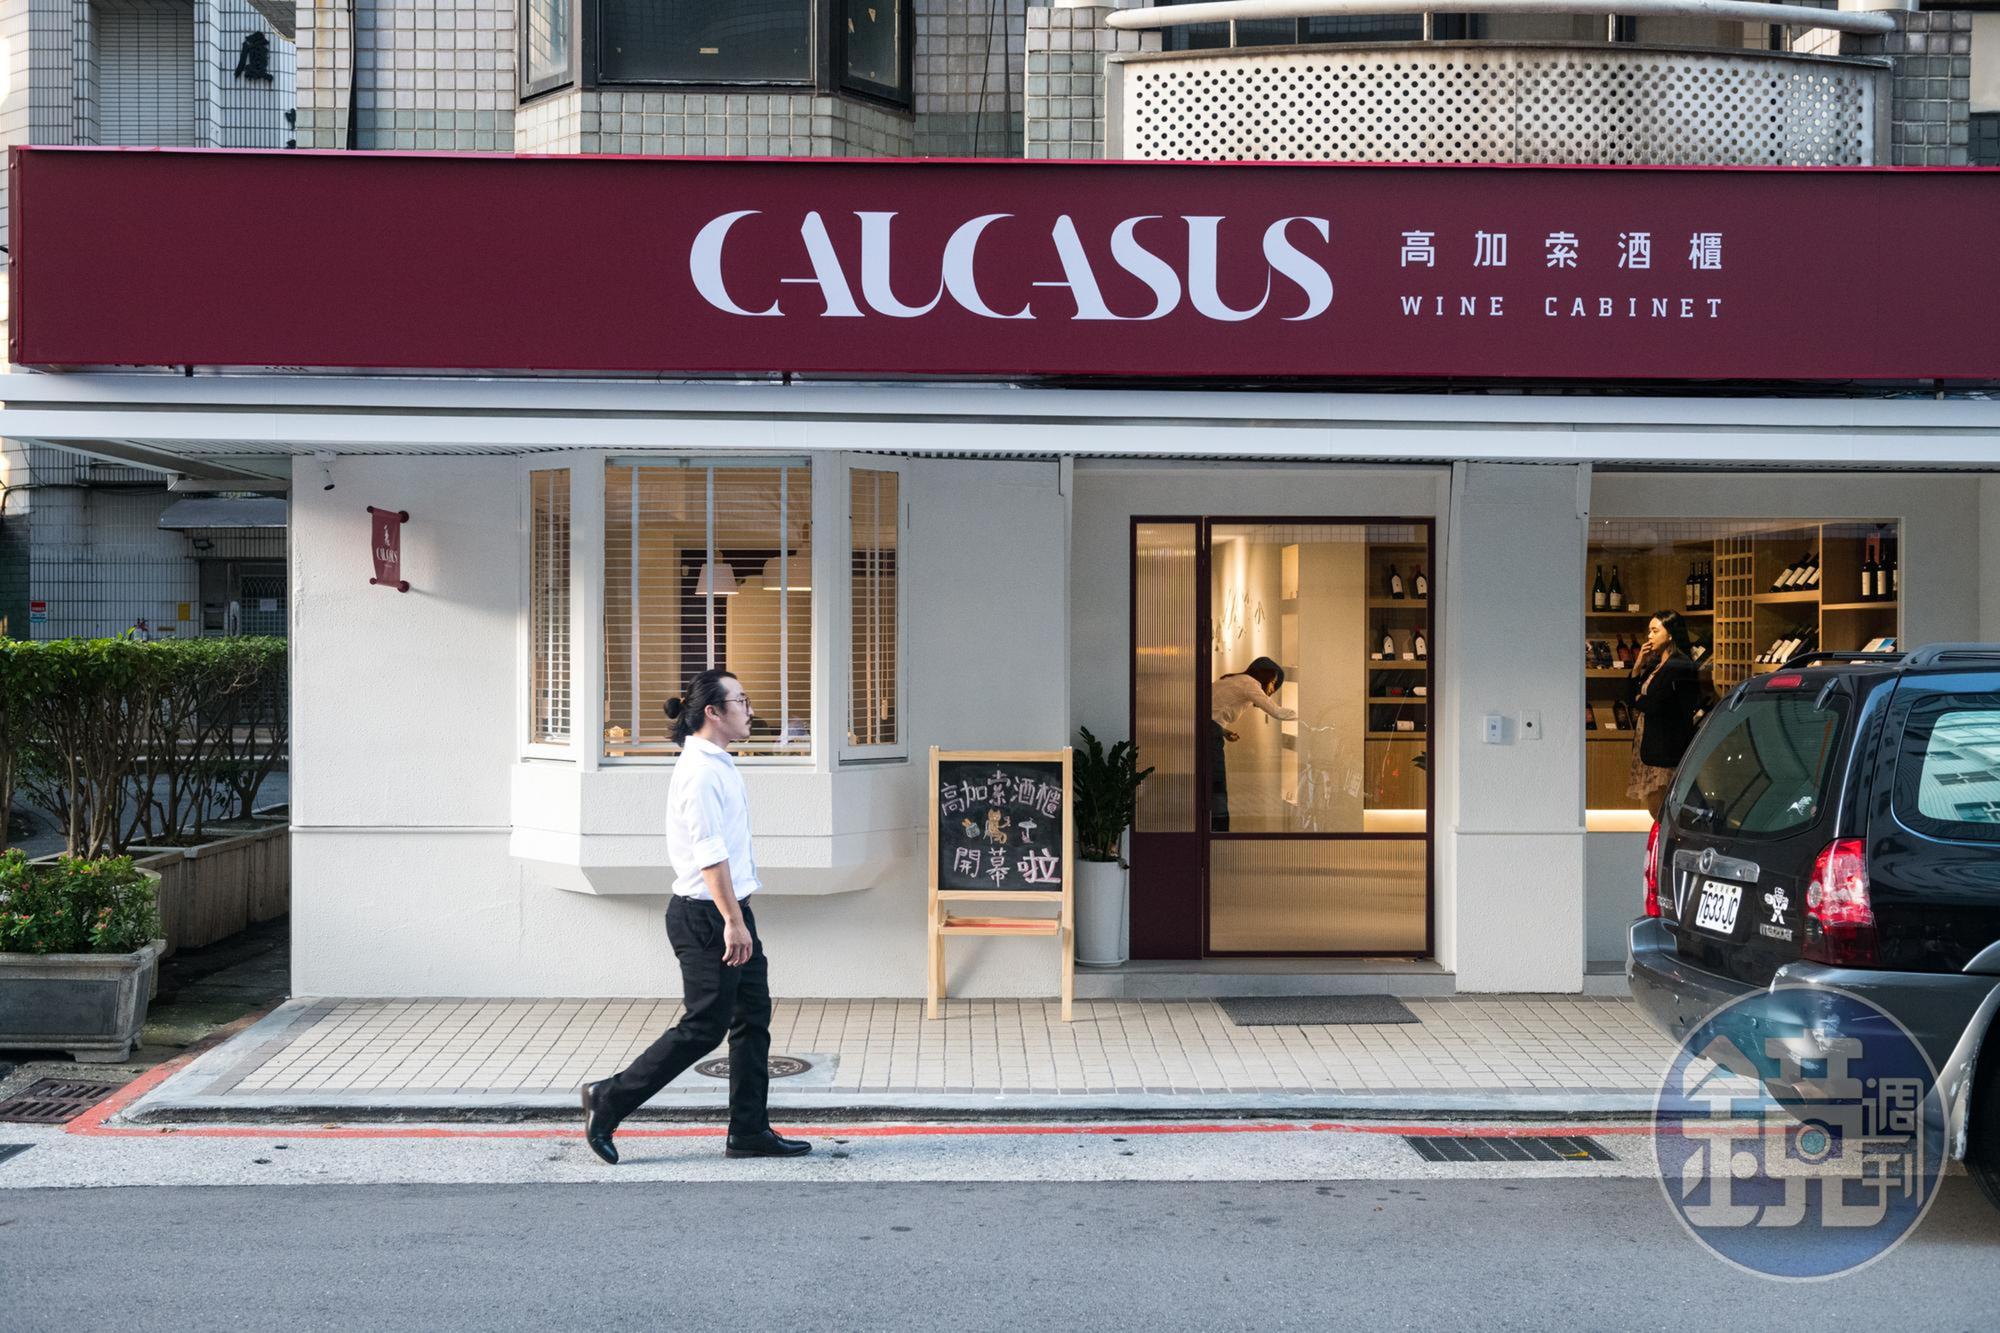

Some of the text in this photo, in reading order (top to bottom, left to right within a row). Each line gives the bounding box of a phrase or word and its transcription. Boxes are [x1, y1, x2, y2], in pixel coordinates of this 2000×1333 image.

[689, 210, 1334, 322] CAUCASUS
[1401, 230, 1722, 270] 高加索酒櫃
[1401, 296, 1722, 318] WINE CABINET
[941, 770, 1062, 819] 高加索酒櫃
[954, 847, 1061, 888] 開幕啦
